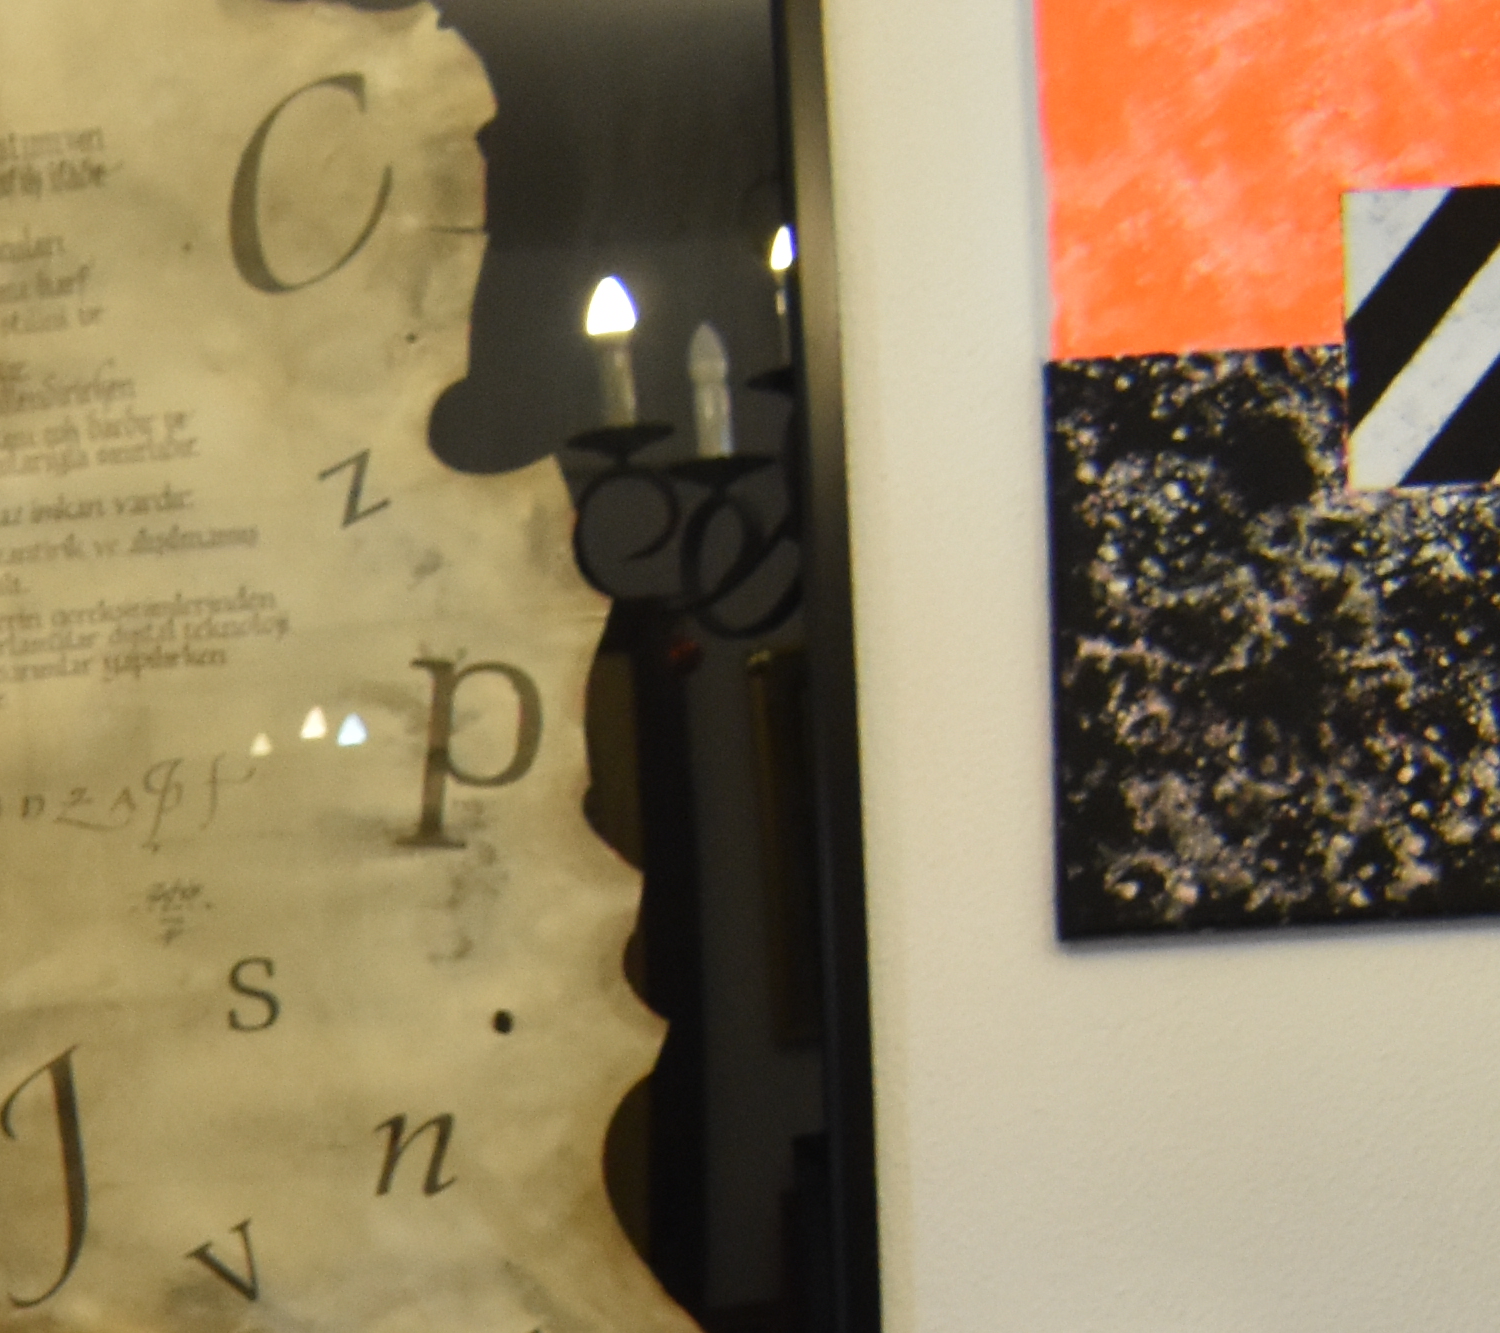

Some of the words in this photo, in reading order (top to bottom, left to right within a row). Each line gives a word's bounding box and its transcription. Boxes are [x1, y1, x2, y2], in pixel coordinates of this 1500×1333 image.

[227, 72, 394, 297] C
[408, 655, 544, 852] p
[0, 1045, 88, 1309] J
[373, 1110, 457, 1198] n
